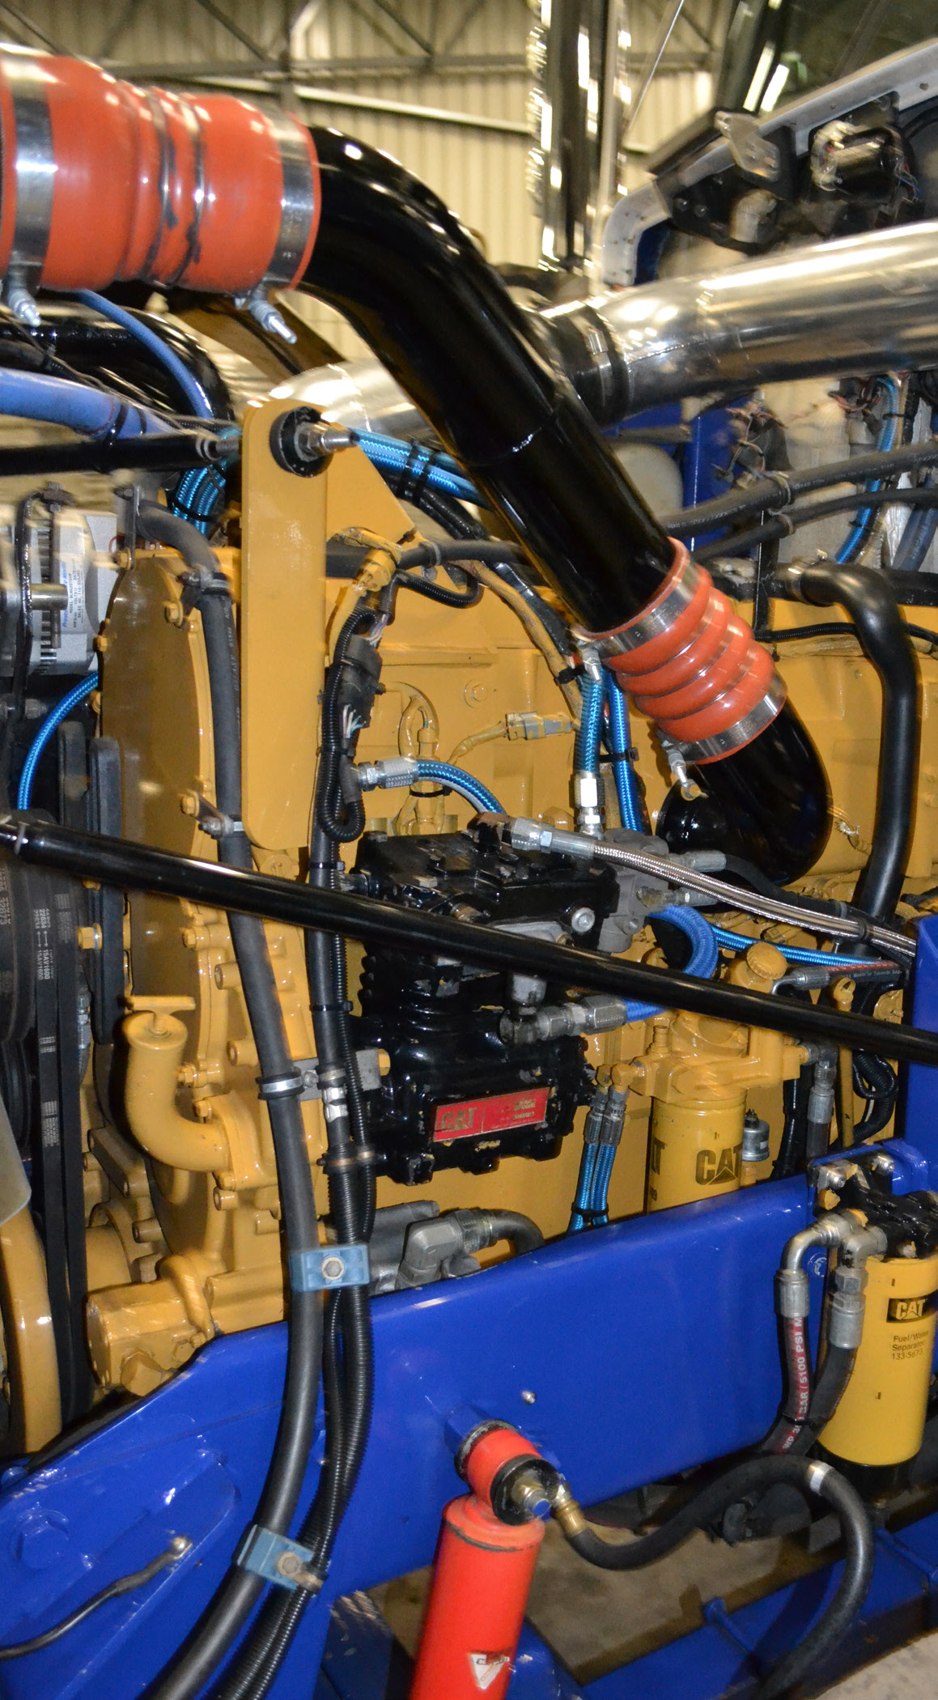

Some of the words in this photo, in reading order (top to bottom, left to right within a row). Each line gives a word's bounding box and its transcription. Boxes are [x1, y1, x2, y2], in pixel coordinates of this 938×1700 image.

[695, 1142, 743, 1186] CAT
[895, 1299, 926, 1320] CAT
[795, 1331, 805, 1353] PSI
[797, 1357, 808, 1384] 5100
